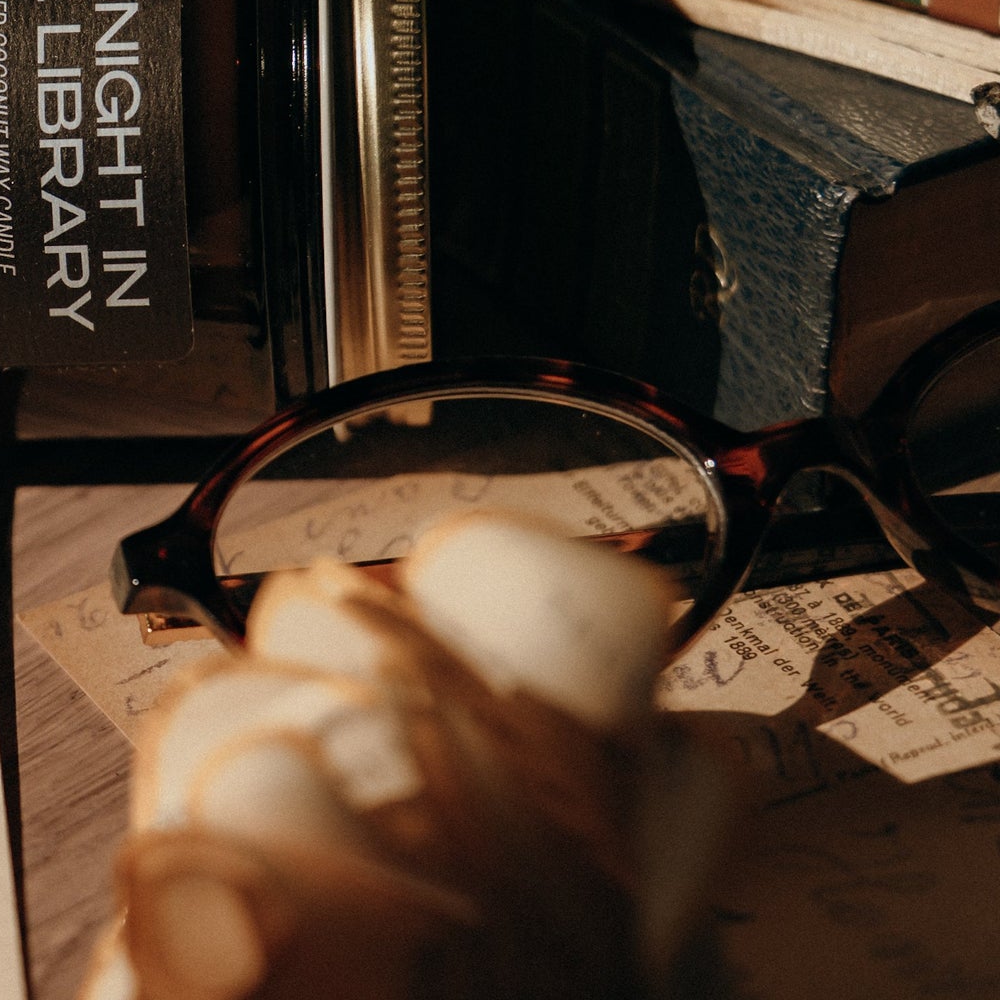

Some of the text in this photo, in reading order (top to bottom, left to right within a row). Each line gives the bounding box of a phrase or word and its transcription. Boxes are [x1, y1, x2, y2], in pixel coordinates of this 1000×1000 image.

[36, 24, 95, 331] LIBRARY
[103, 250, 149, 307] IN
[724, 636, 758, 660] 1889
[744, 590, 819, 653] onstruction
[773, 658, 801, 678] der
